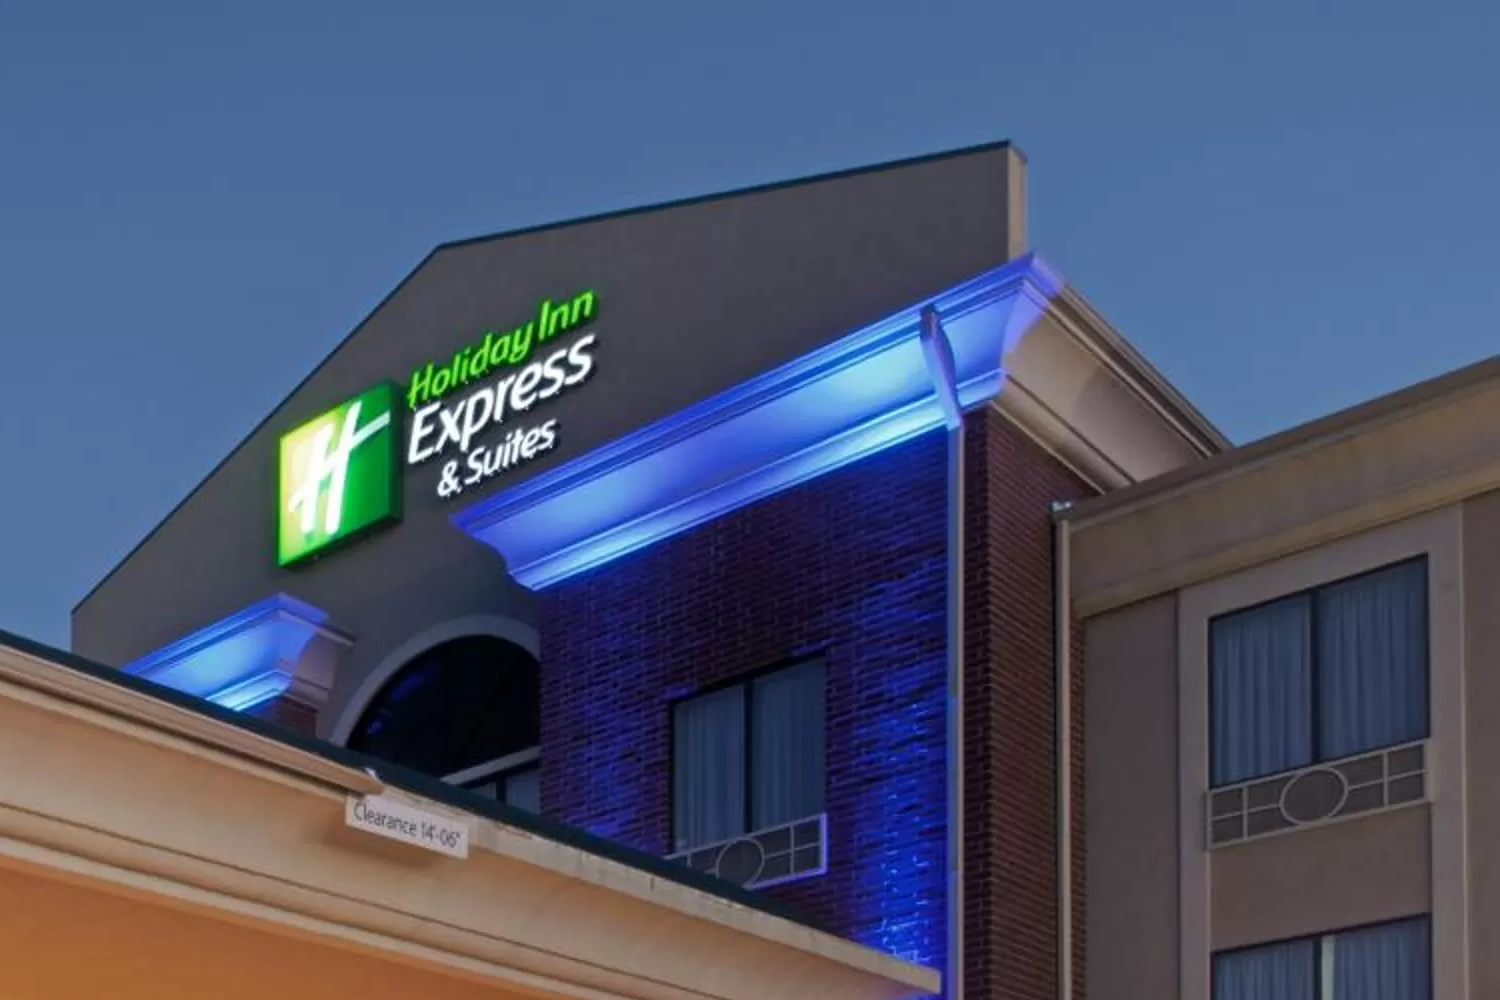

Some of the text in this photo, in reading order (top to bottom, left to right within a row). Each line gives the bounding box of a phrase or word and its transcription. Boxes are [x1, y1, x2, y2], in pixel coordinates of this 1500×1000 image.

[406, 289, 595, 409] Holiday Inn
[408, 334, 596, 464] Express
[437, 418, 557, 497] & Suites
[354, 802, 417, 837] Clearance
